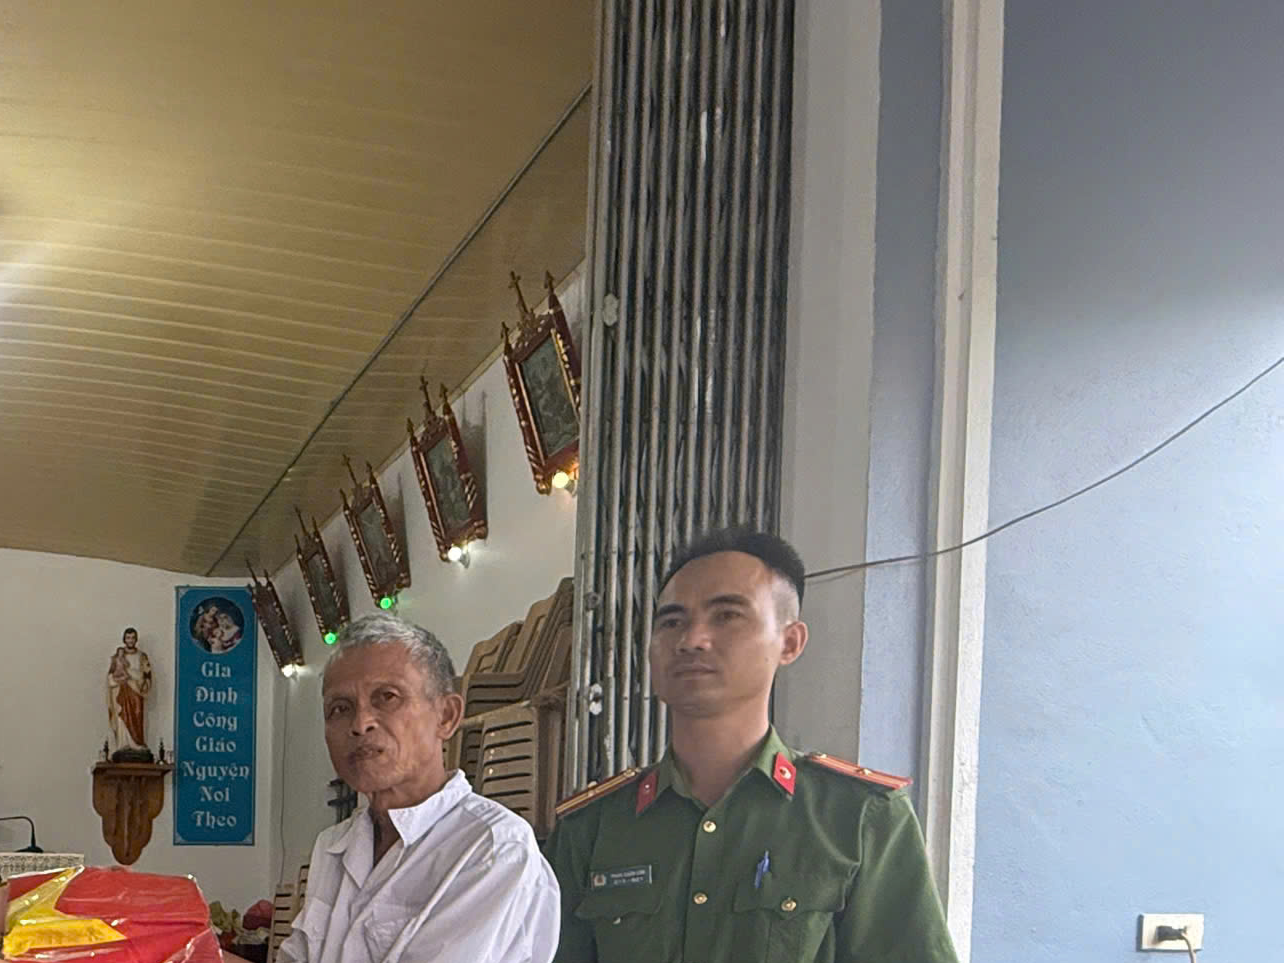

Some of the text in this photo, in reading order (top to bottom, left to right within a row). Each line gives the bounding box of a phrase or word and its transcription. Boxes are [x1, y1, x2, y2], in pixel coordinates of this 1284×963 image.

[201, 661, 232, 678] Gia
[192, 711, 238, 732] Công
[192, 810, 237, 829] Theo
